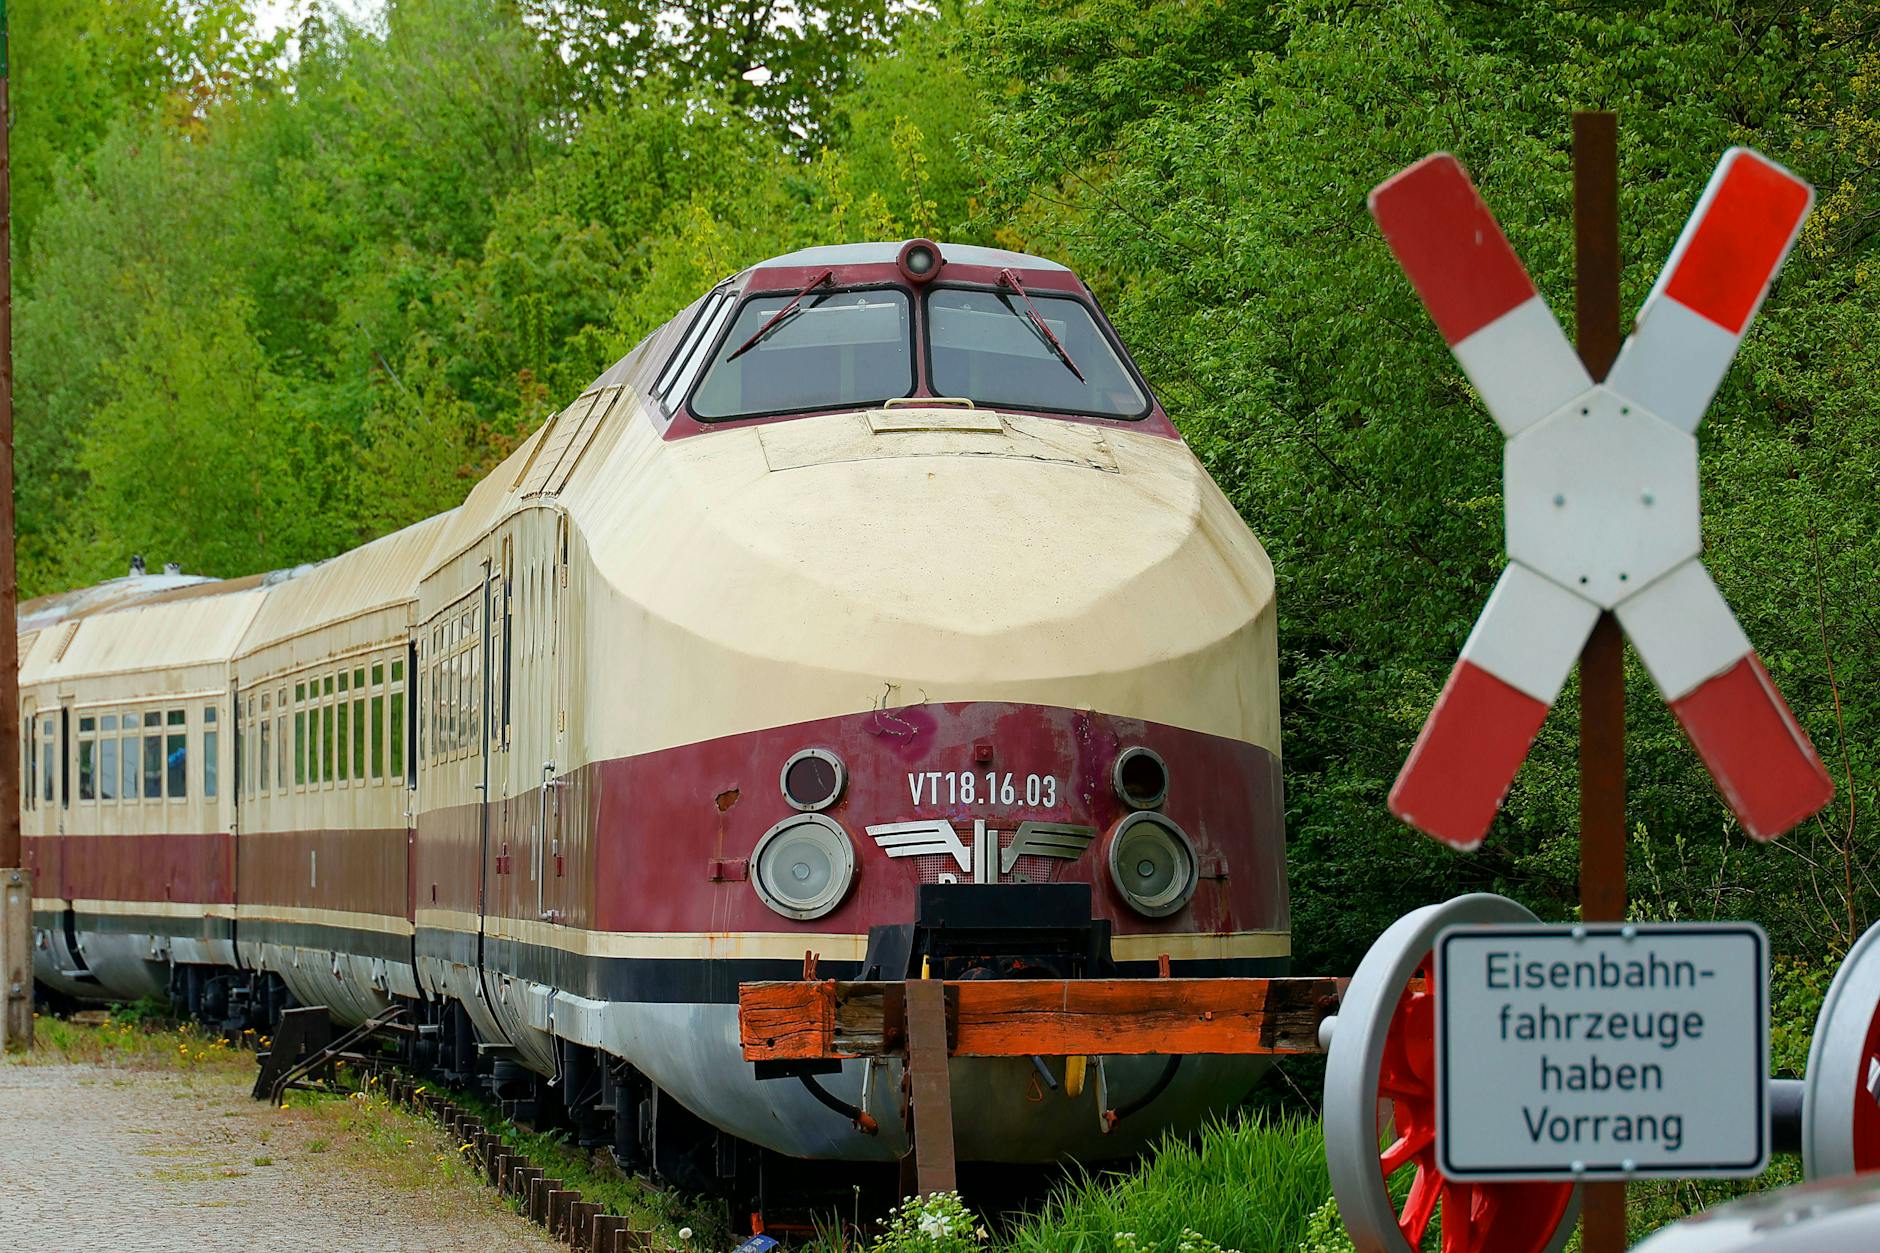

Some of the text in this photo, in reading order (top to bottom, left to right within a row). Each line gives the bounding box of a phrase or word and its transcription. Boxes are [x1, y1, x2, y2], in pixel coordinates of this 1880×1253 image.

[907, 771, 1056, 808] VT18.16.03
[1485, 951, 1715, 989] Eisenbahn-
[1499, 1004, 1704, 1049] fahrzeuge
[1540, 1055, 1663, 1091] haben
[1522, 1105, 1683, 1152] Vorrang
